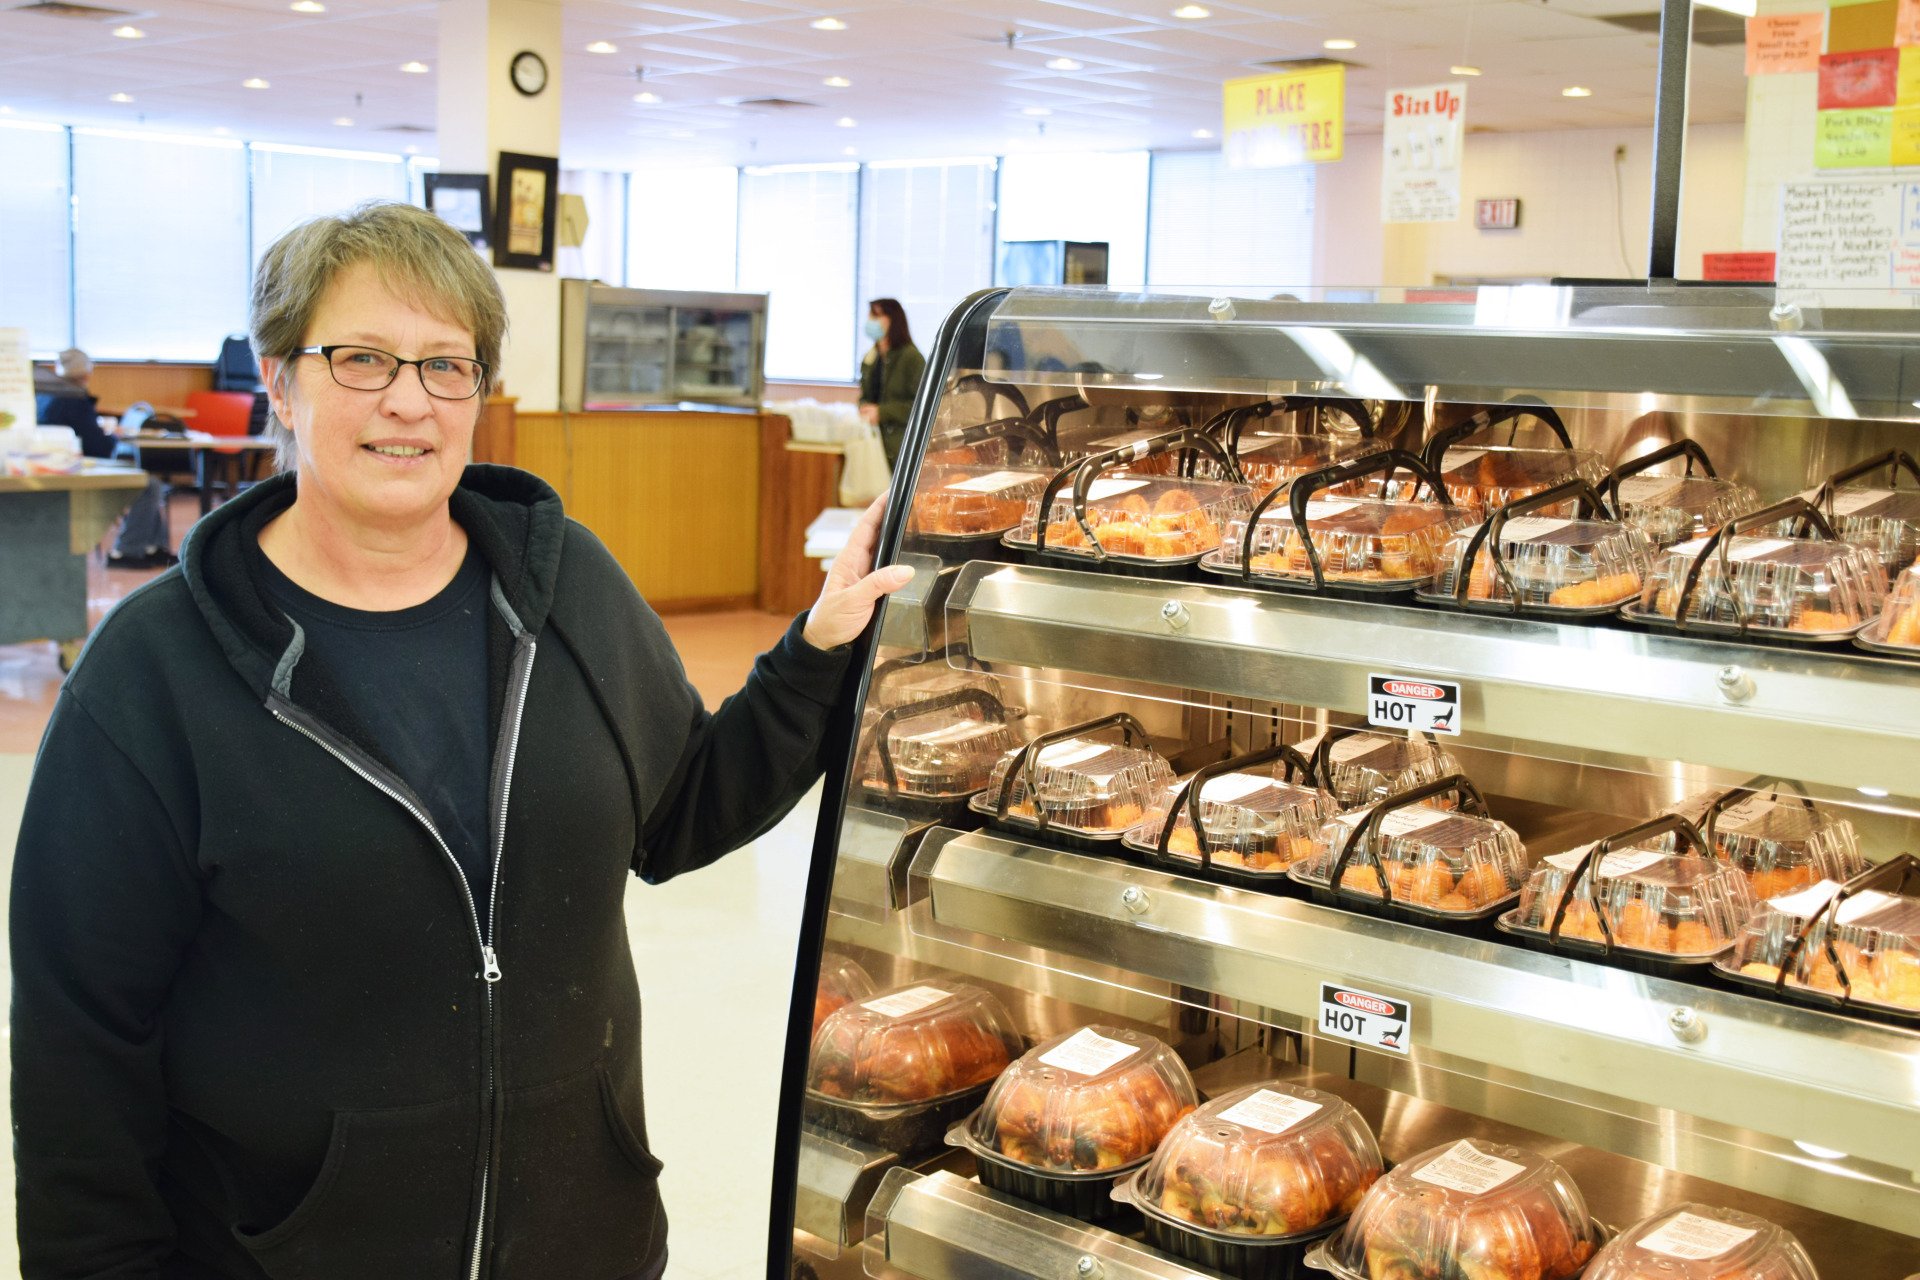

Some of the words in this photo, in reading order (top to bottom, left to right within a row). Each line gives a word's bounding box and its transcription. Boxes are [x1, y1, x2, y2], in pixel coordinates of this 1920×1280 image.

[1256, 83, 1306, 115] PLACE
[1393, 92, 1430, 118] Size
[1434, 89, 1461, 120] Up
[1478, 200, 1514, 225] EXIT
[1391, 682, 1436, 698] DANGER
[1375, 700, 1416, 723] HOT
[1342, 993, 1387, 1014] DANGER
[1325, 1008, 1367, 1035] HOT
